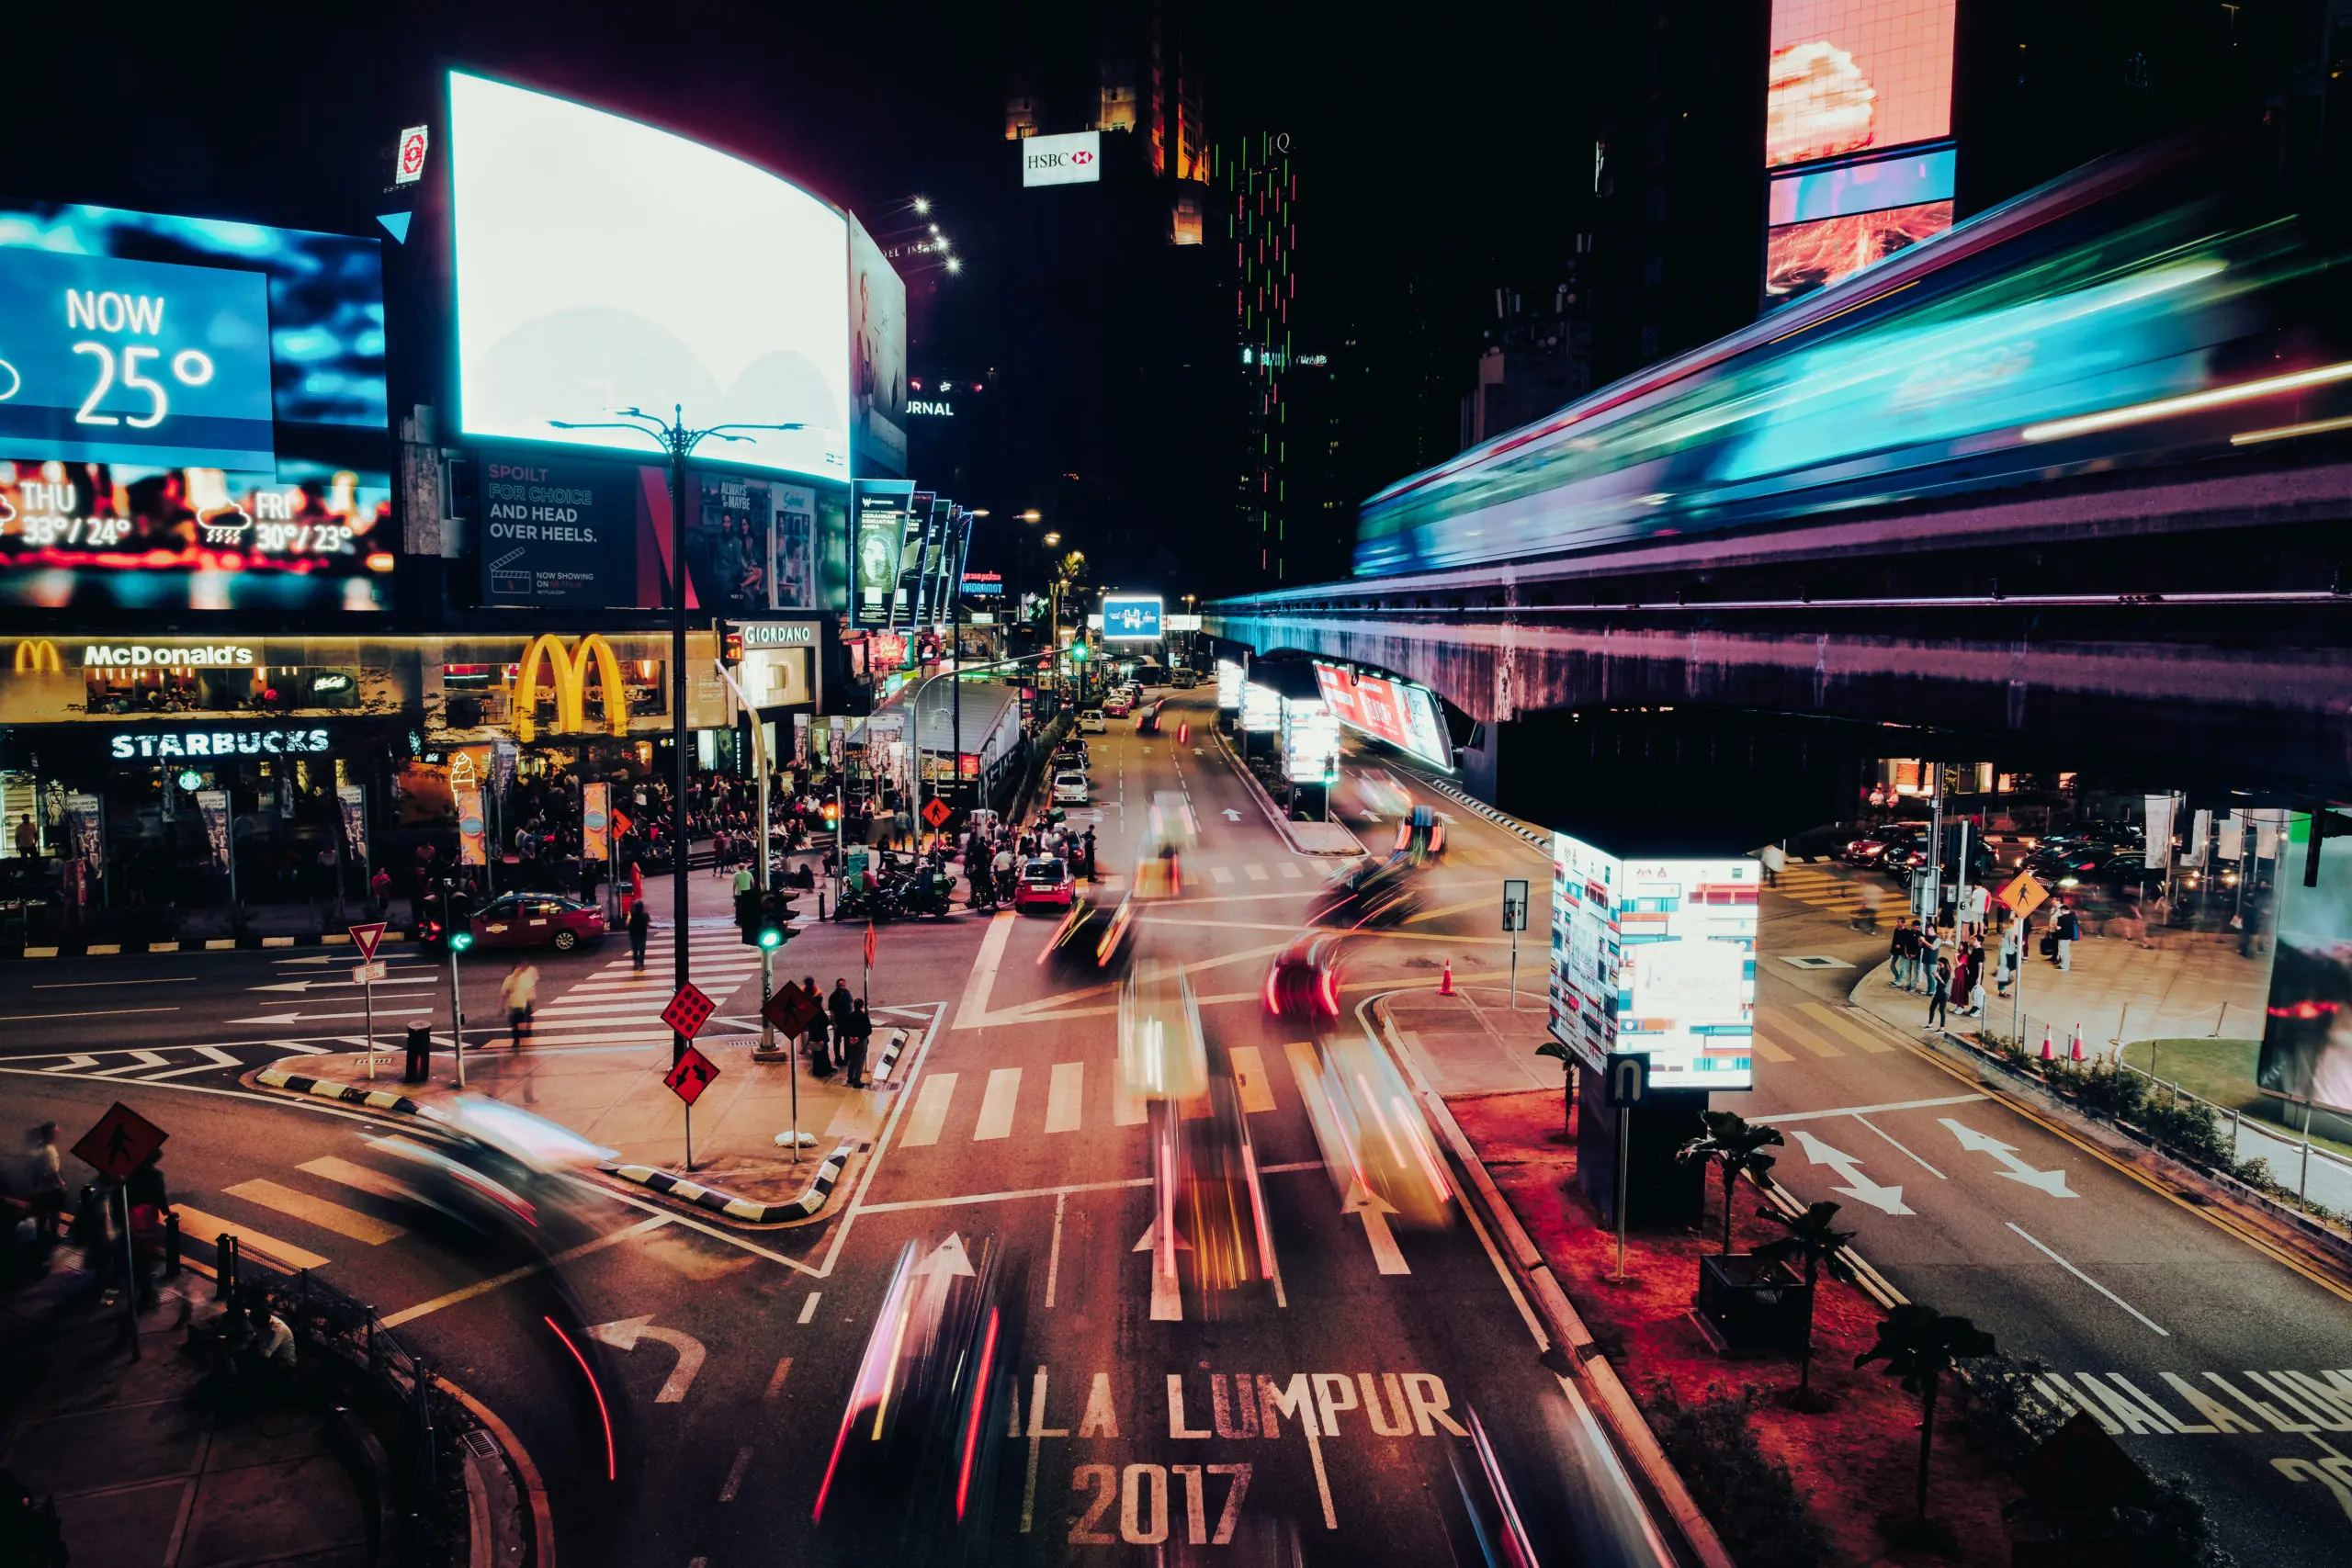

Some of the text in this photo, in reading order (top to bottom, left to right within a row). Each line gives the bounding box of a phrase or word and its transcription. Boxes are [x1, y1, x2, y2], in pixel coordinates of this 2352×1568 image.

[1027, 152, 1069, 169] HSBC
[65, 288, 164, 334] NOW
[73, 342, 215, 428] 25°
[489, 464, 548, 482] SPOILT
[20, 482, 75, 513] THU
[489, 483, 593, 505] FOR CHOICE
[720, 482, 747, 497] ALWAYS
[256, 492, 291, 519] FRI
[490, 503, 577, 523] AND HEAD
[728, 495, 751, 511] MAYBE
[490, 523, 597, 543] OVER HEELS.
[537, 571, 594, 581] NOW SHOWING
[744, 626, 810, 645] GIORDANO
[84, 646, 253, 665] McDonald's
[111, 728, 329, 759] STARBUCKS
[1167, 1372, 1471, 1438] LUMPUR
[2005, 1371, 2264, 1436] UALA
[1068, 1462, 1253, 1545] 2017
